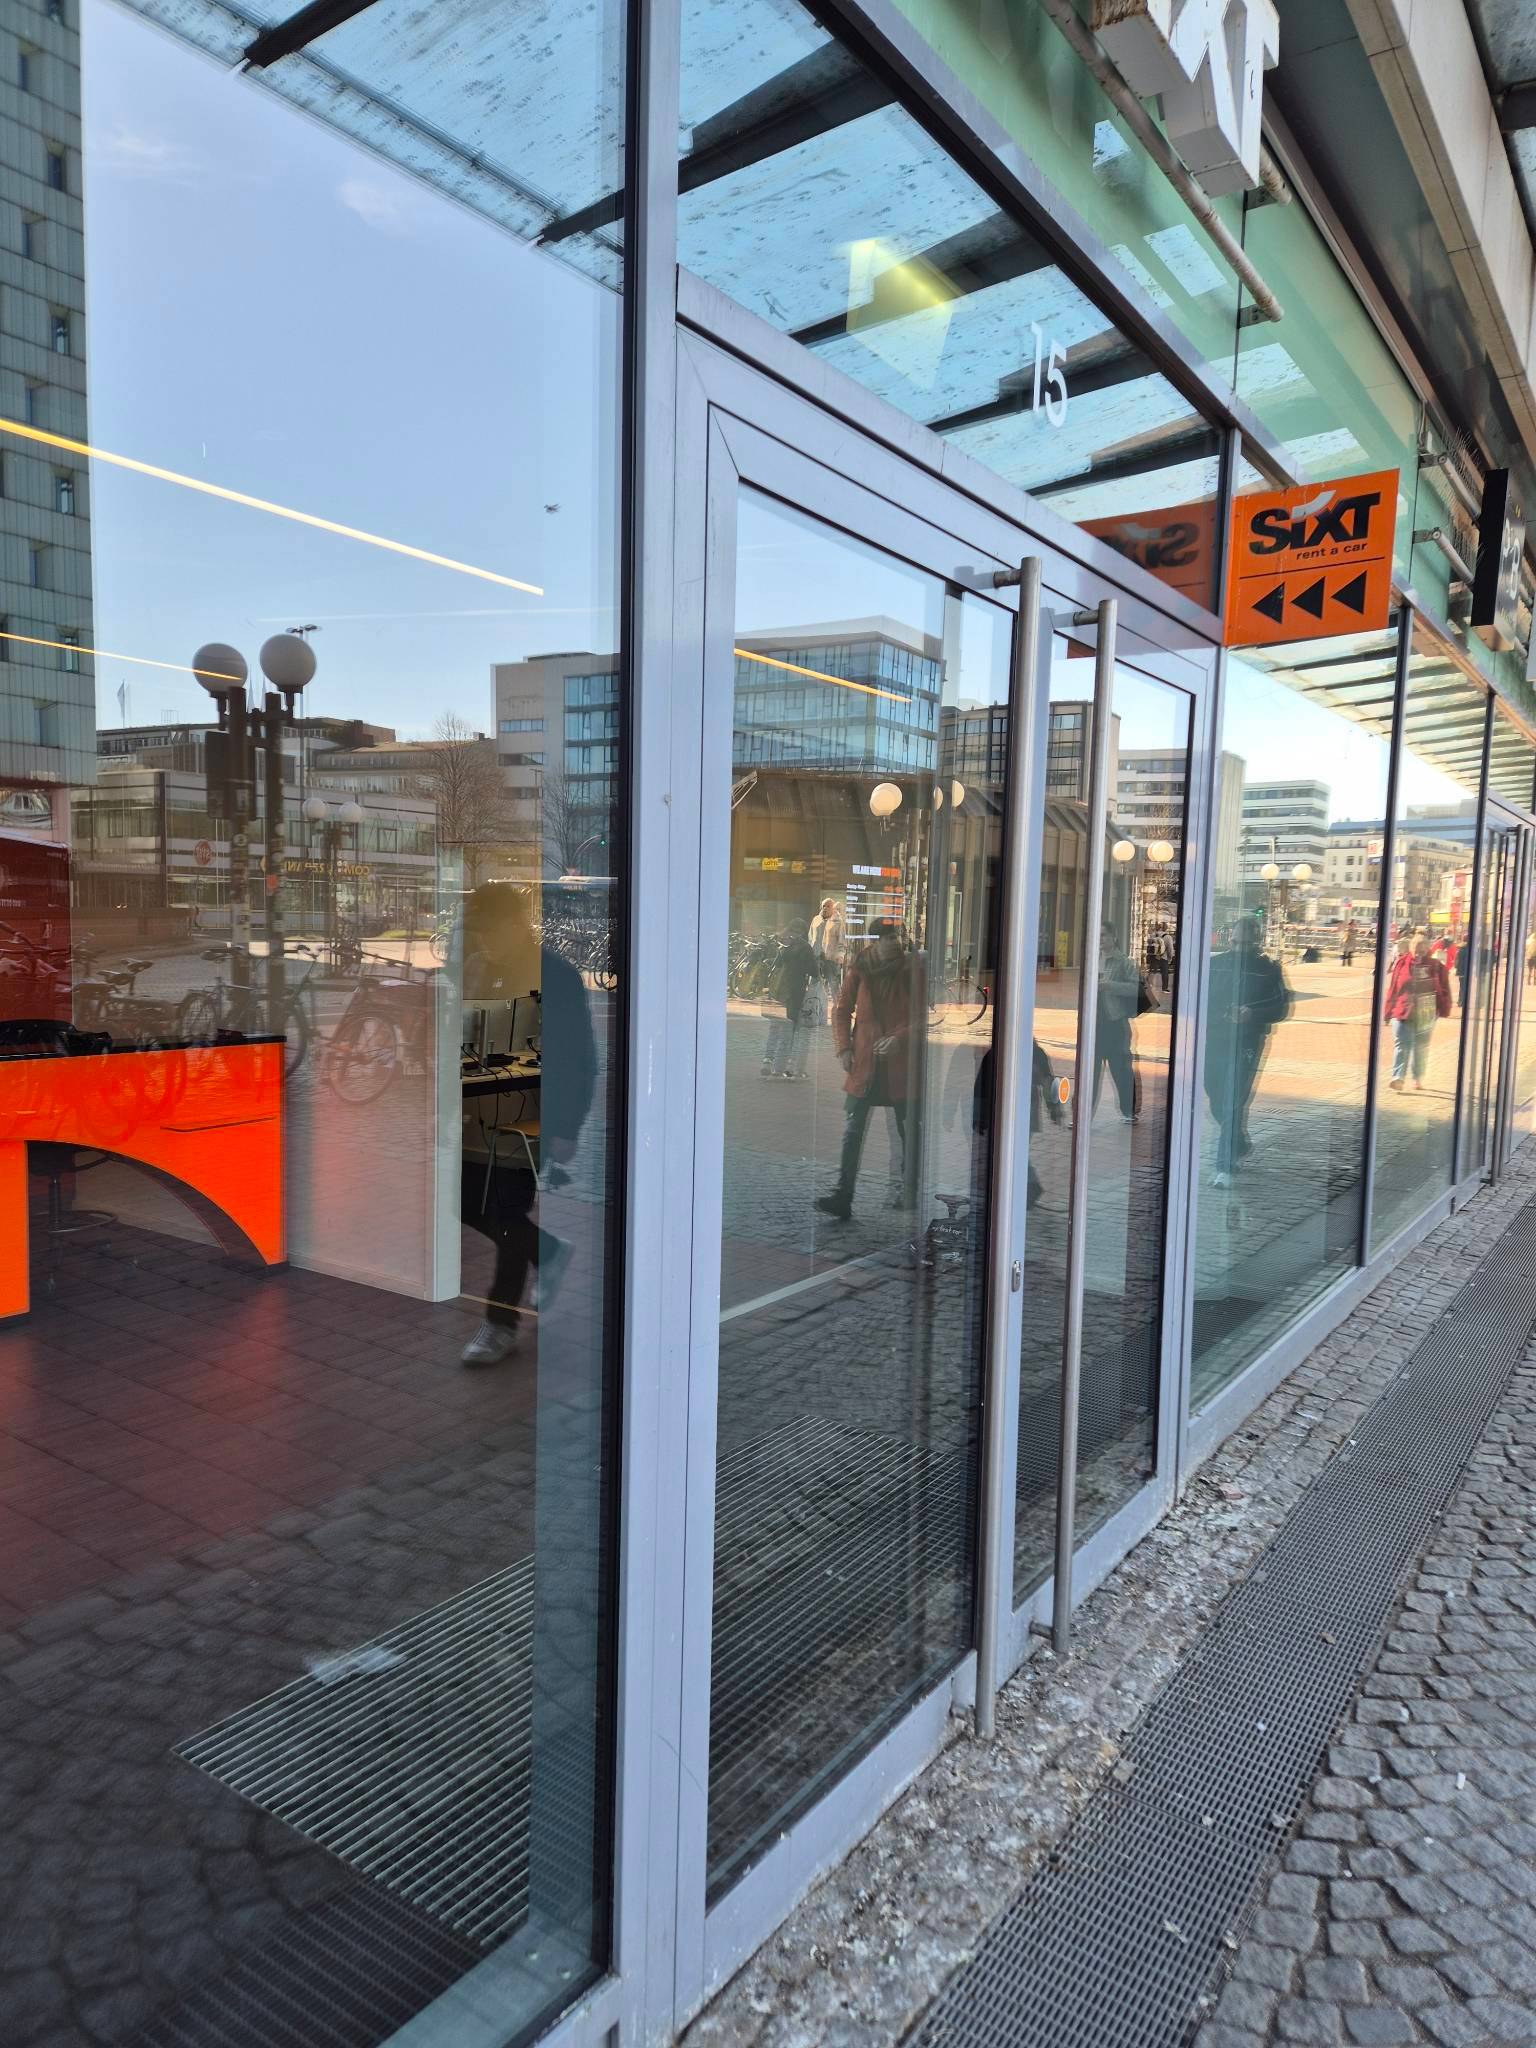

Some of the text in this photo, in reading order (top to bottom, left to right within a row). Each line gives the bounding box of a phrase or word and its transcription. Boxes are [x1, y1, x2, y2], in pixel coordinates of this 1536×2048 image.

[1030, 321, 1068, 427] 15
[1249, 490, 1381, 555] SIXT
[1296, 541, 1367, 560] rent a car
